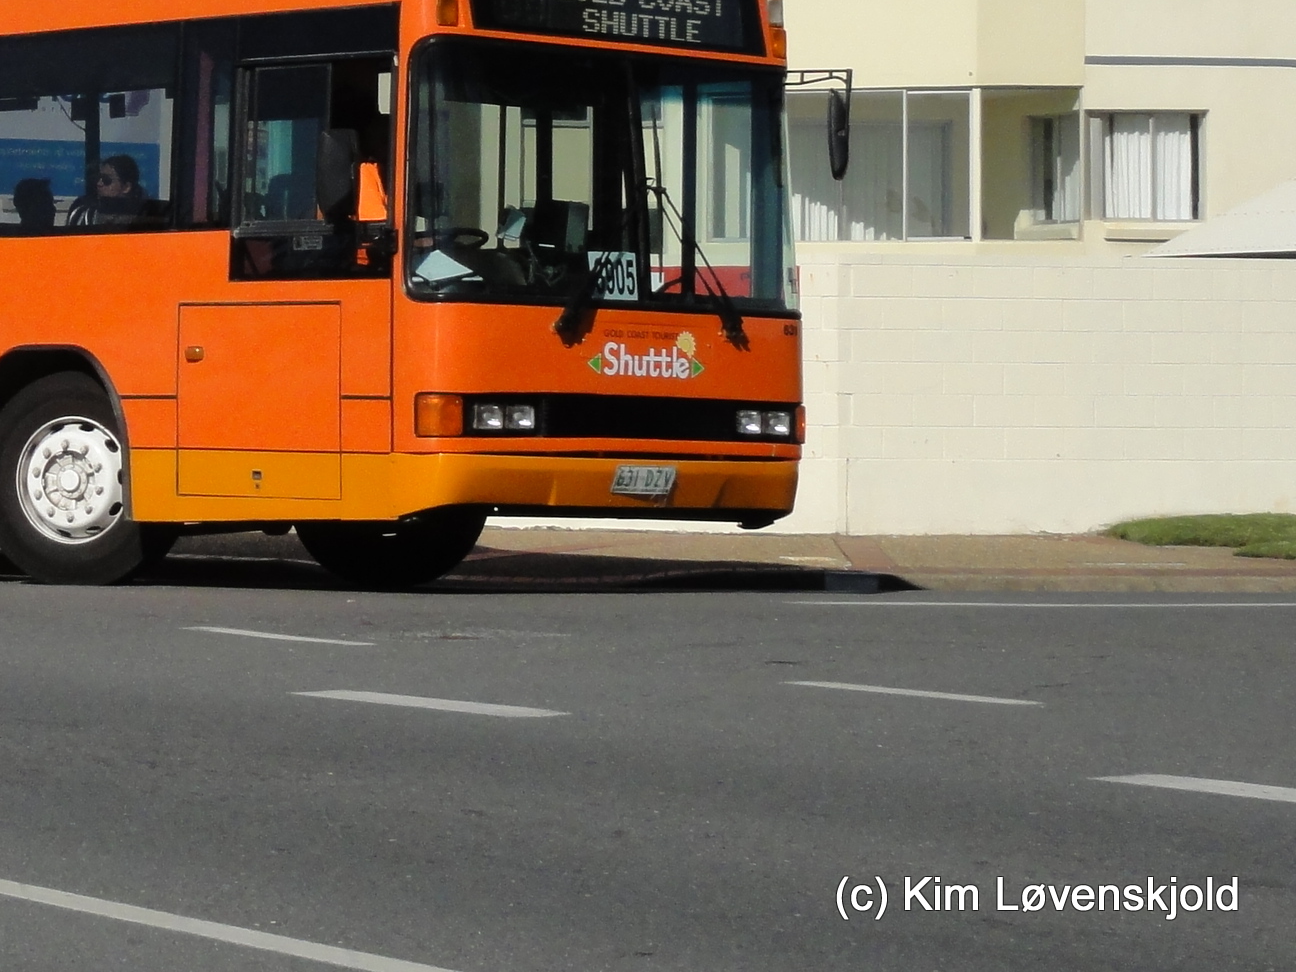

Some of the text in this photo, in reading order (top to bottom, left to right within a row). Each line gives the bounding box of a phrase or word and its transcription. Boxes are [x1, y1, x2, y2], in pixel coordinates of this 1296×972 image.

[582, 8, 702, 43] SHUTTLE
[604, 329, 623, 338] GOLD
[627, 330, 648, 339] COAST
[603, 341, 690, 379] Shuttle
